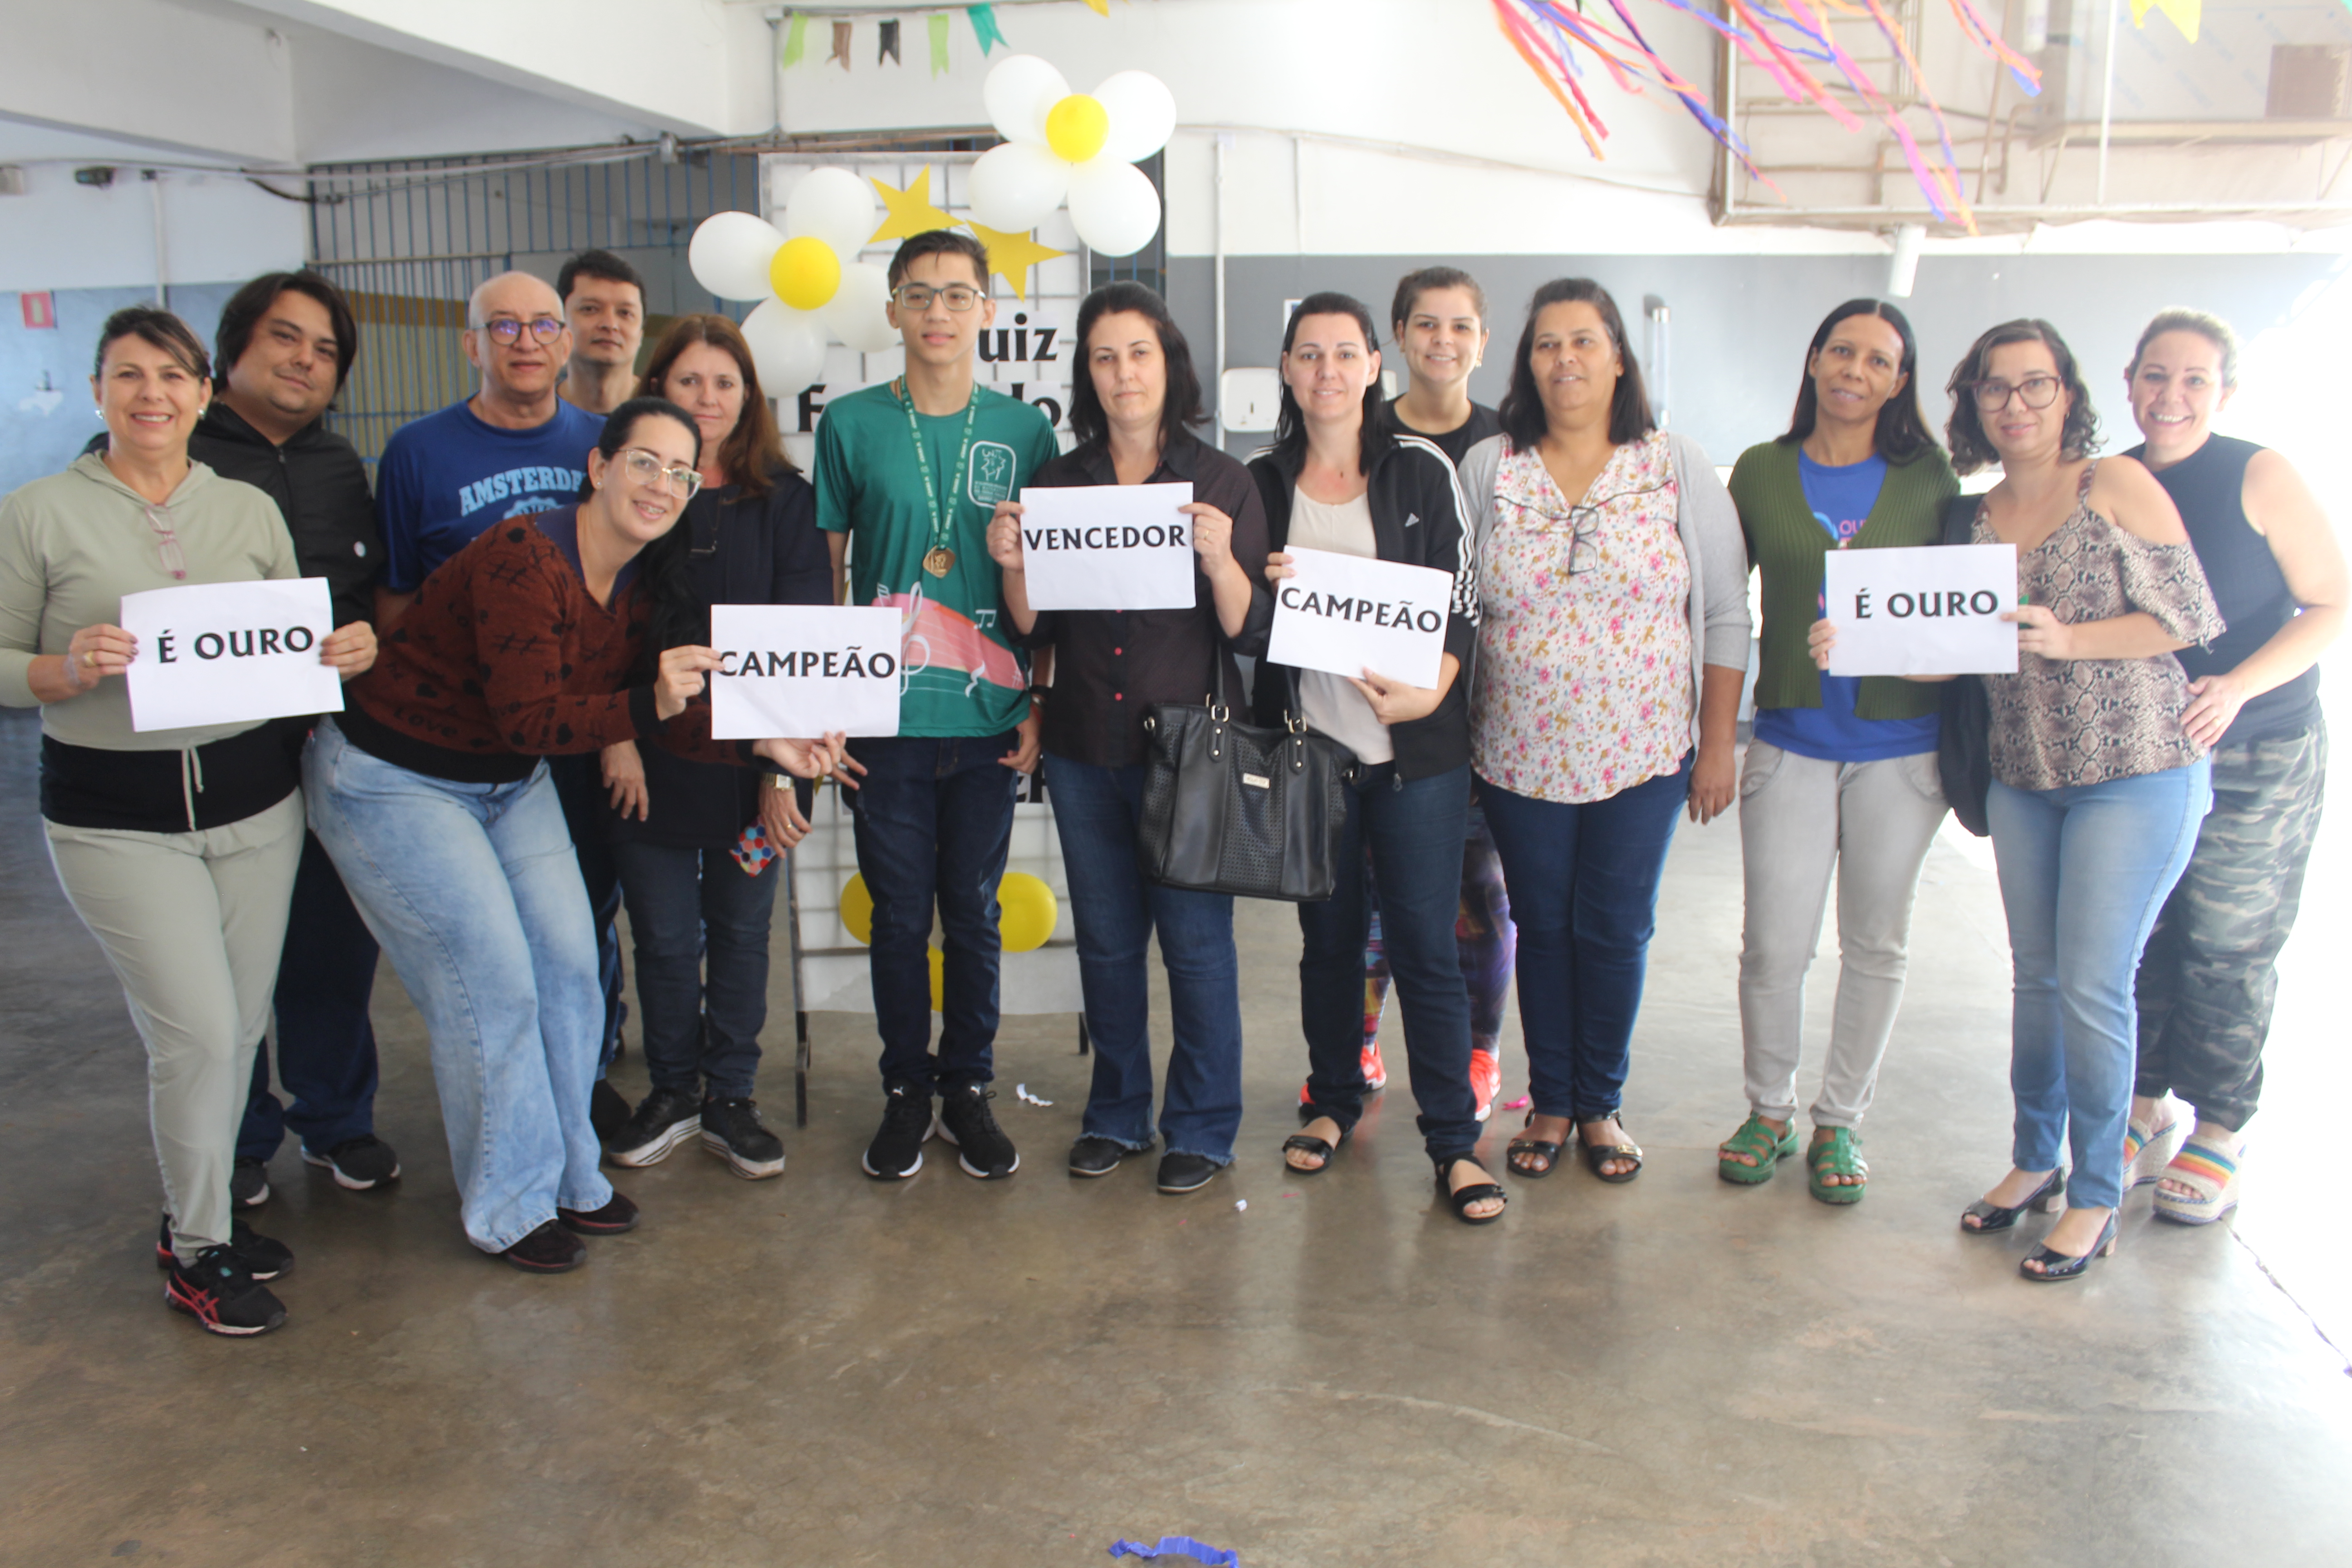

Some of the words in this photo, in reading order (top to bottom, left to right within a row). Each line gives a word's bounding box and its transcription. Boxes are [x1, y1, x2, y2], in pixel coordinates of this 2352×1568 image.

[978, 312, 1058, 362] uiz
[1024, 524, 1187, 550] VENCEDOR
[1281, 587, 1442, 633] CAMPEÃO
[1855, 588, 1873, 619] É
[1887, 589, 1999, 618] OURO
[158, 629, 178, 664] É
[194, 626, 314, 660] OURO
[719, 645, 896, 678] CAMPEÃO
